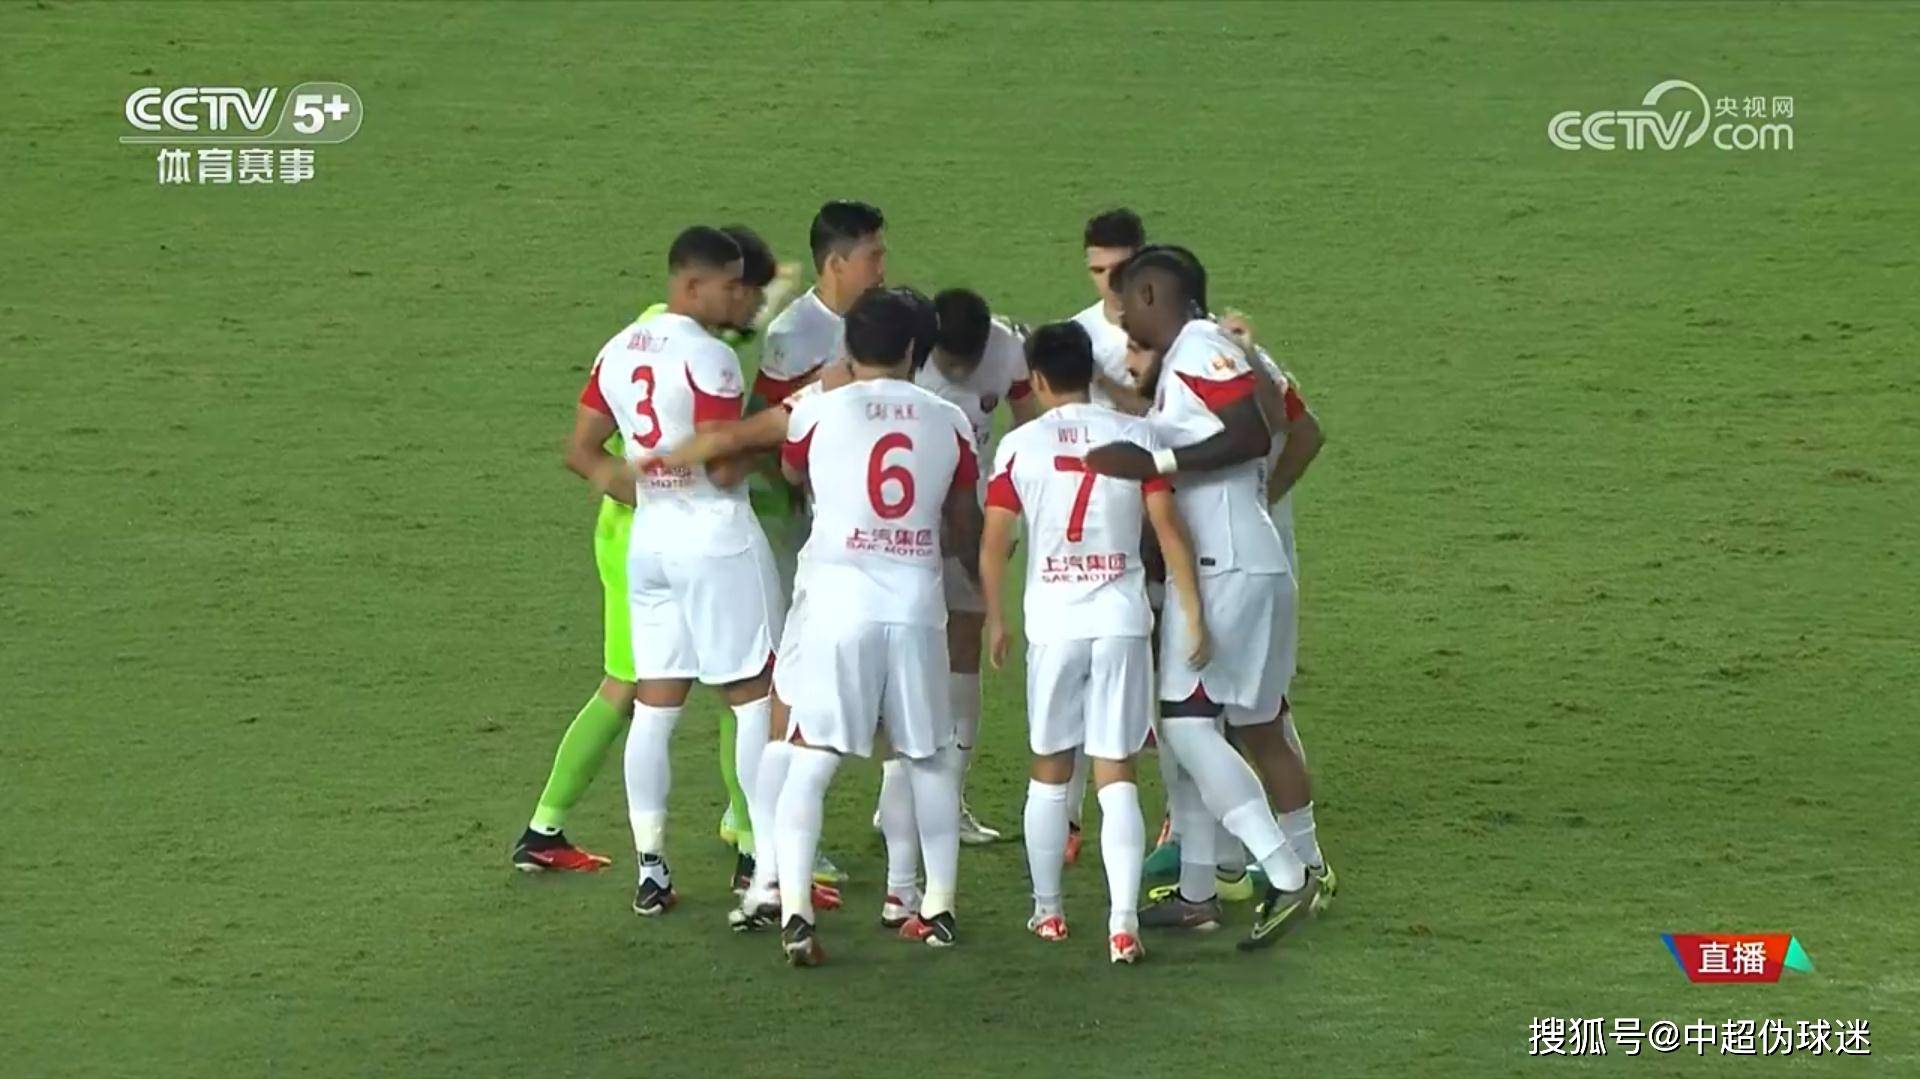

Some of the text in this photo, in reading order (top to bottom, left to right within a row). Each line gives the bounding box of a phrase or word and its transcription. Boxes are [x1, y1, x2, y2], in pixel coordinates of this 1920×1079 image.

[630, 365, 663, 449] 3
[866, 431, 916, 520] 6
[1053, 455, 1098, 543] 7
